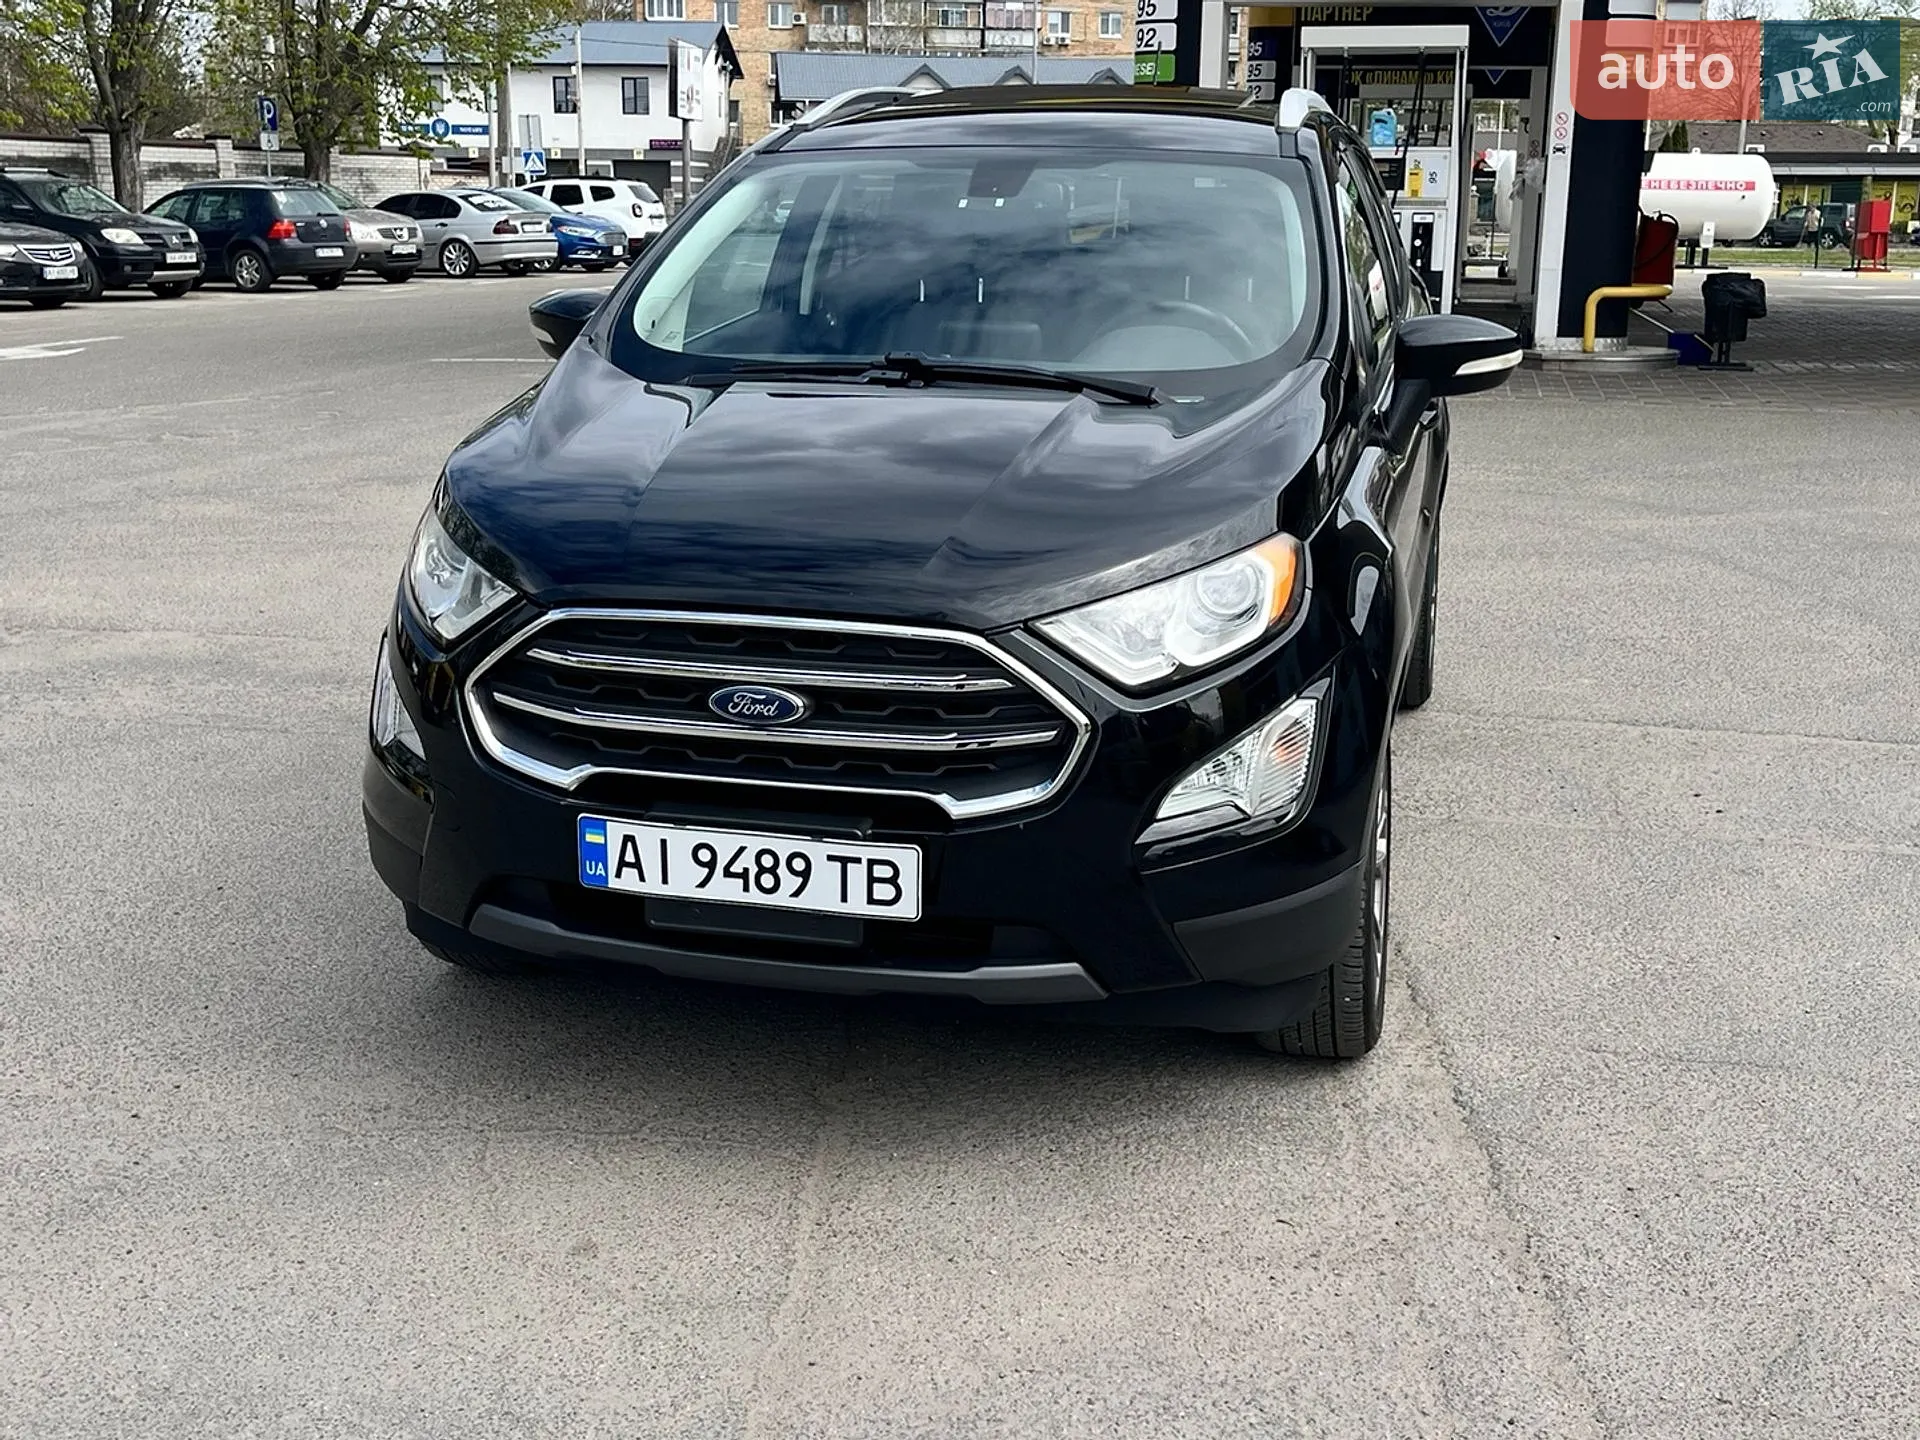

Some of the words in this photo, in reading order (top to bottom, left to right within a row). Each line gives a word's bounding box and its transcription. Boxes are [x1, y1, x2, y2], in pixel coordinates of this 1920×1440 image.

[1137, 0, 1157, 18] 95
[1136, 27, 1157, 49] 92
[727, 691, 780, 716] Ford
[586, 861, 606, 877] UA
[614, 833, 669, 885] AI
[691, 842, 812, 898] 9489
[826, 854, 903, 906] TB
